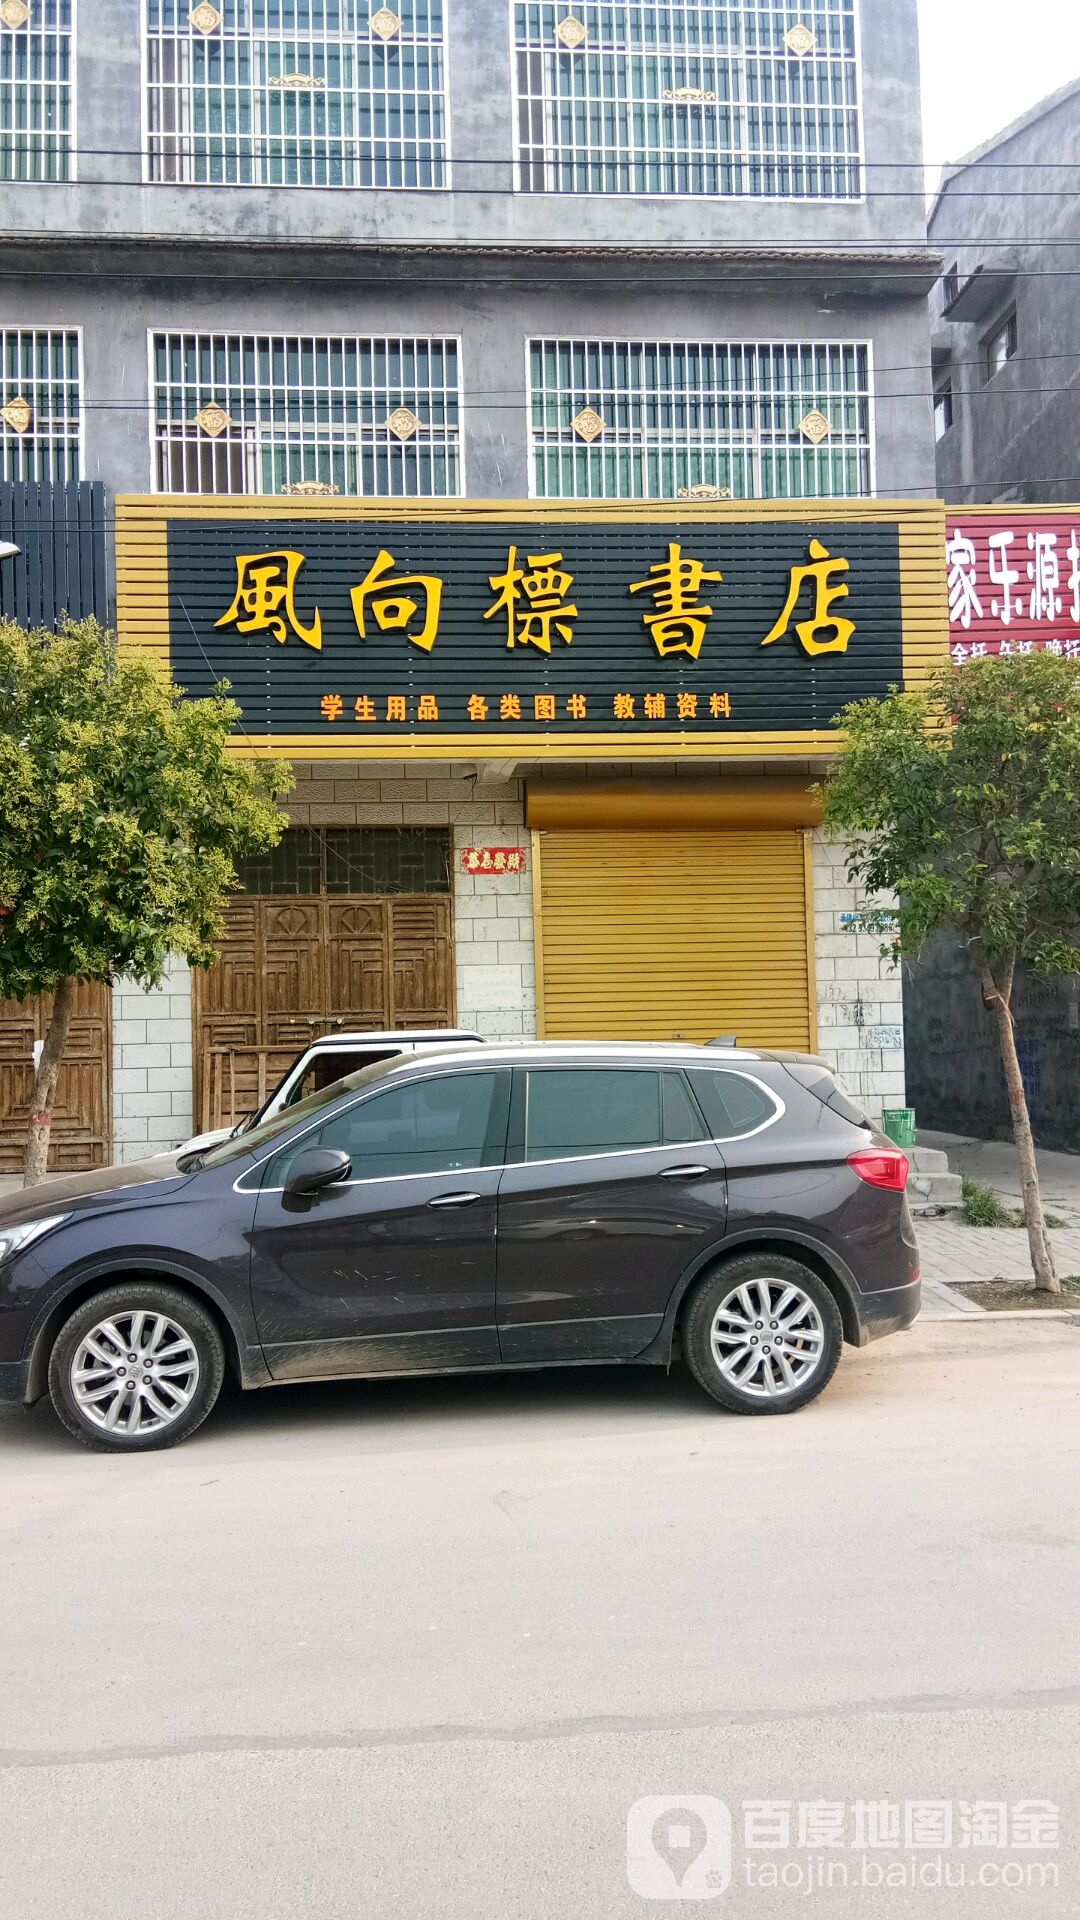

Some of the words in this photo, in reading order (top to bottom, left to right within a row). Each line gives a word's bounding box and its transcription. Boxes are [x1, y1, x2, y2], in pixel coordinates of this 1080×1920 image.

[213, 539, 858, 660] 風向標書店
[320, 694, 439, 721] 学生用品
[467, 693, 587, 721] 各类图书
[613, 692, 732, 719] 教辅资料
